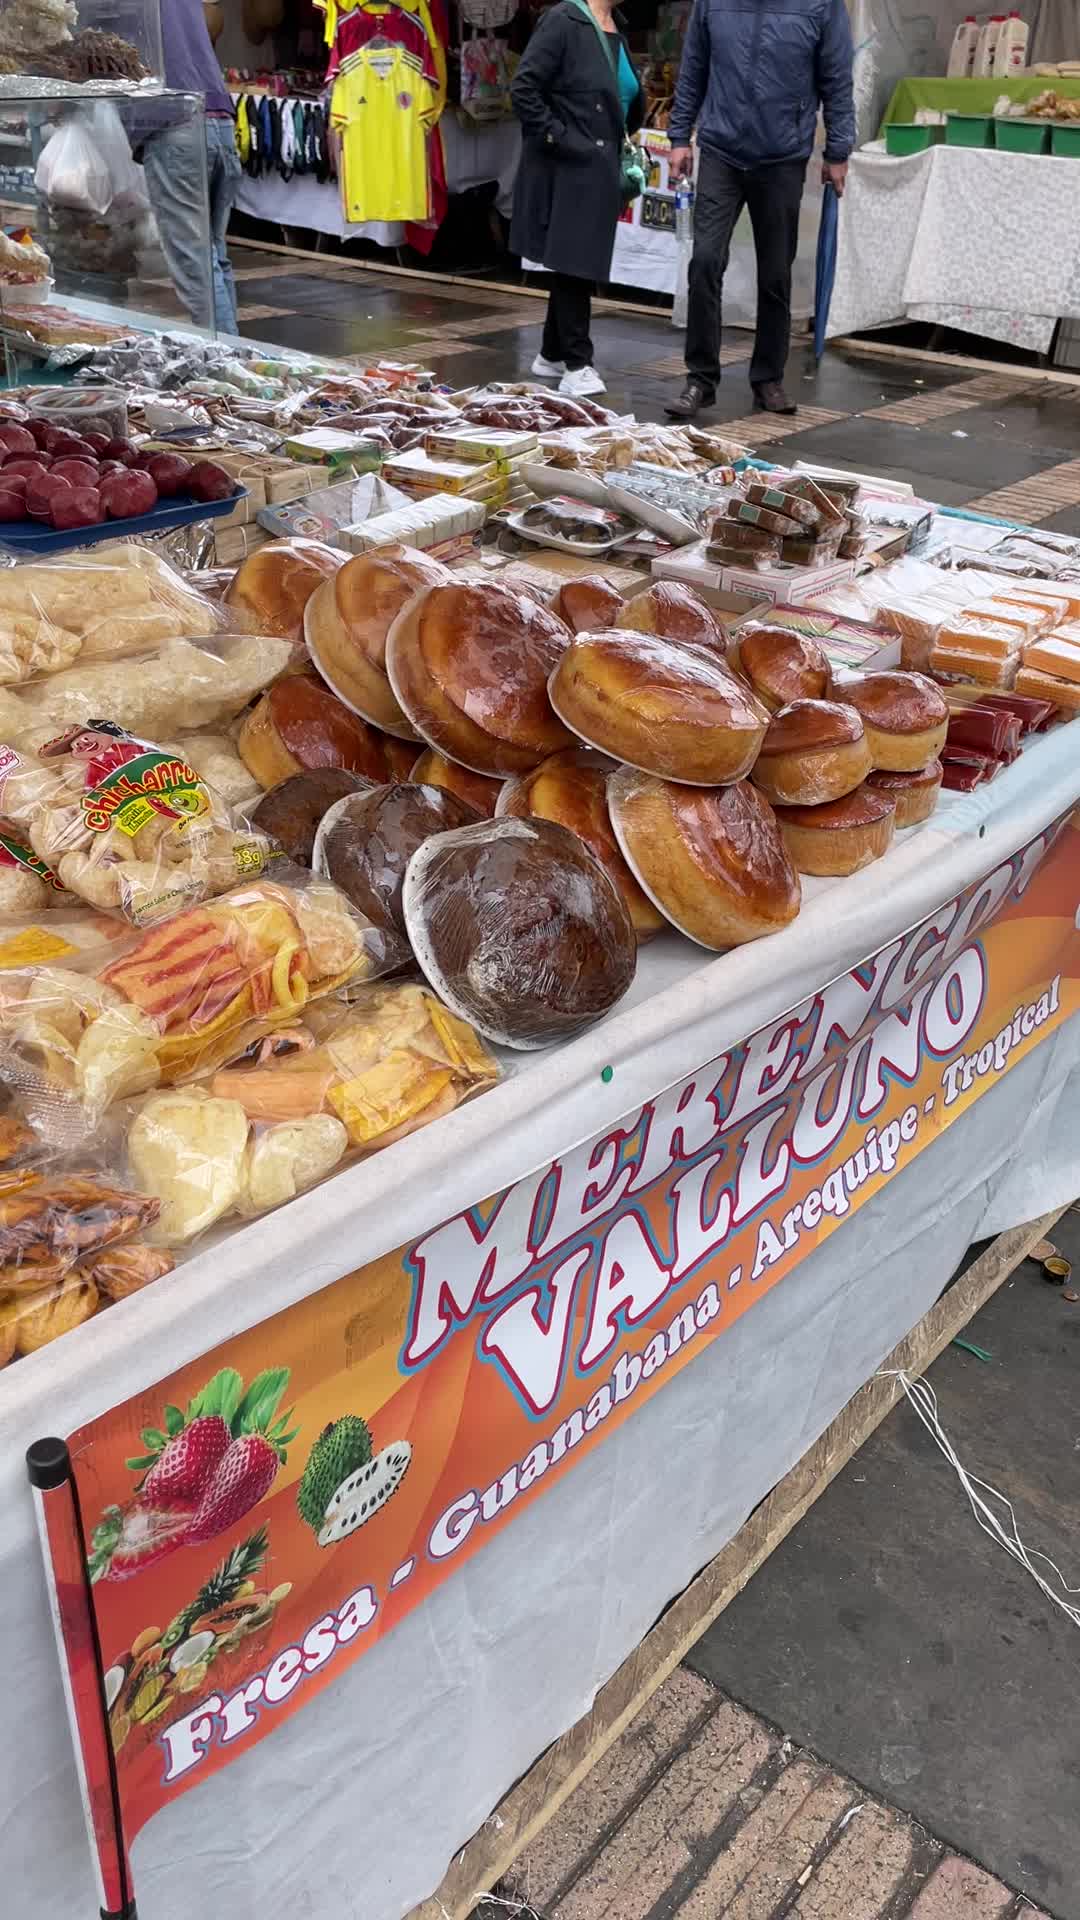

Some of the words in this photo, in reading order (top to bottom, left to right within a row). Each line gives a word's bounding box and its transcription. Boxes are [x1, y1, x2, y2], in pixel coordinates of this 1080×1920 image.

[160, 1582, 379, 1785] Fresa
[428, 1280, 721, 1559] Guanabana
[750, 1100, 920, 1281] Arequipe
[941, 973, 1061, 1107] Tropical
[482, 941, 985, 1415] VALLUNO
